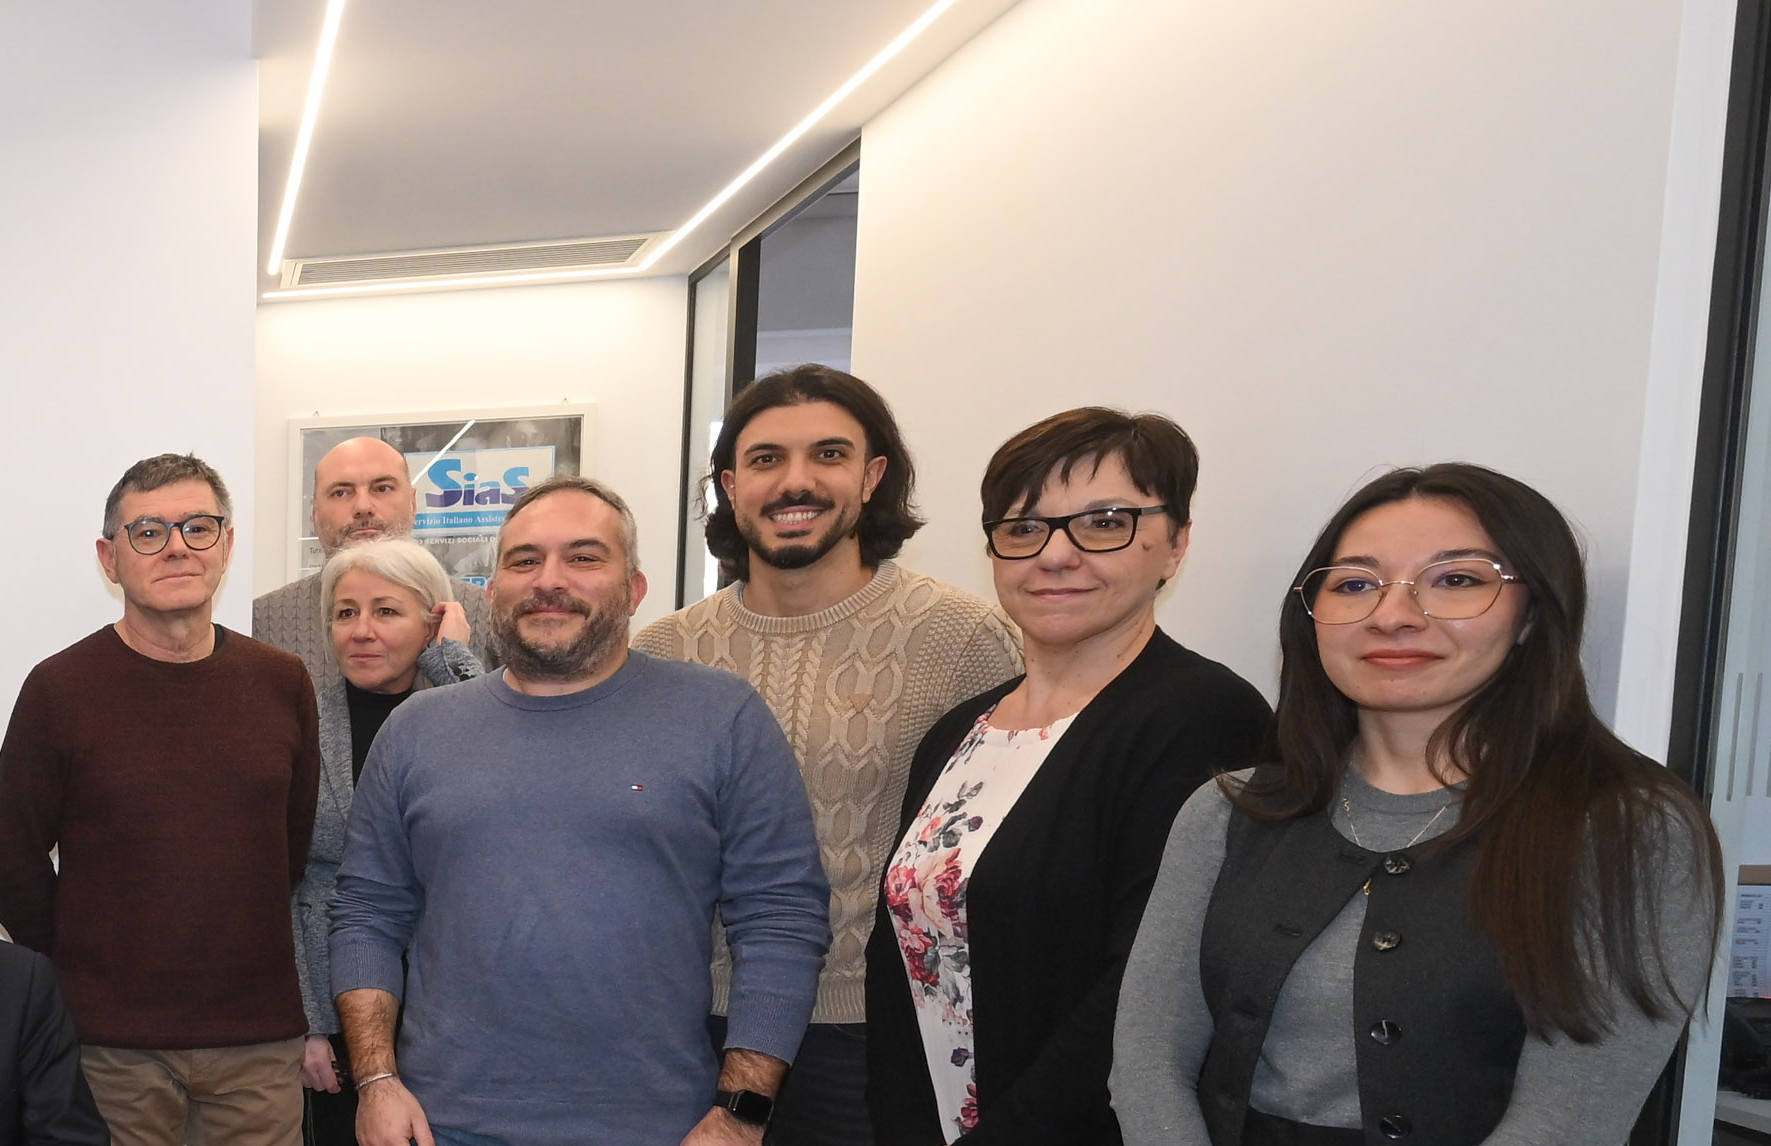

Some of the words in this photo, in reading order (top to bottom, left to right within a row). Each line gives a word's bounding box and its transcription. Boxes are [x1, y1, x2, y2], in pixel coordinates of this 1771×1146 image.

[443, 515, 473, 525] Italiano
[424, 537, 455, 545] SERVIZI
[457, 536, 488, 544] SOCIALI
